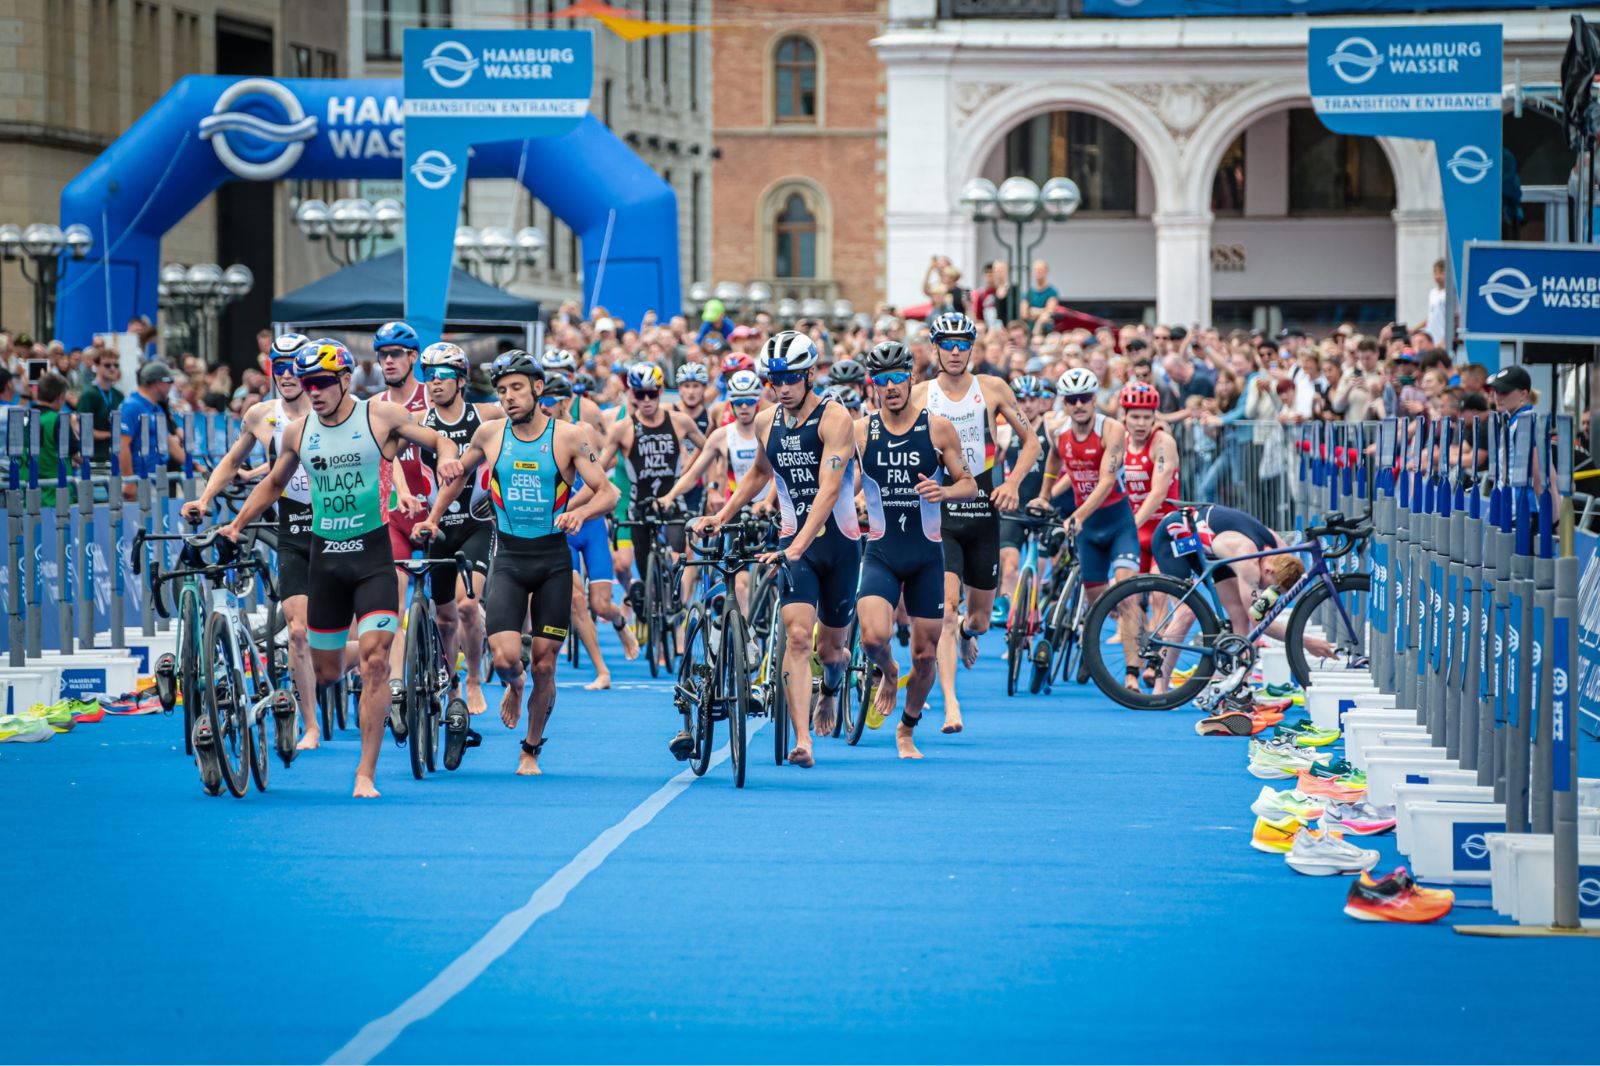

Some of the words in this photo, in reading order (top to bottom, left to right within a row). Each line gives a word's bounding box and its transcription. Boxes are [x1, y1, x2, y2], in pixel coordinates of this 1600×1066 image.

[482, 48, 574, 64] HAMBURG
[1388, 42, 1482, 58] HAMBURG
[483, 64, 553, 79] WASSER
[1389, 58, 1459, 74] WASSER
[410, 102, 497, 113] TRANSITION
[501, 102, 576, 113] ENTRANCE
[1325, 97, 1410, 109] TRANSITION
[1416, 95, 1492, 107] ENTRANCE
[1210, 243, 1247, 264] SS
[1541, 275, 1600, 292] HAMB
[449, 430, 468, 438] NTT
[637, 440, 675, 456] WILDE
[329, 452, 362, 468] JOGOS
[644, 454, 669, 469] NZL
[776, 451, 819, 467] BERGERE
[877, 451, 921, 466] LUIS
[314, 471, 365, 494] VILAÇA
[511, 473, 542, 489] GEENS
[790, 467, 815, 483] FRA
[887, 469, 911, 484] FRA
[507, 487, 550, 503] BEL
[322, 494, 357, 514] POR
[320, 513, 367, 531] BMC
[321, 539, 365, 554] ZOGGS
[1552, 700, 1564, 741] NTT
